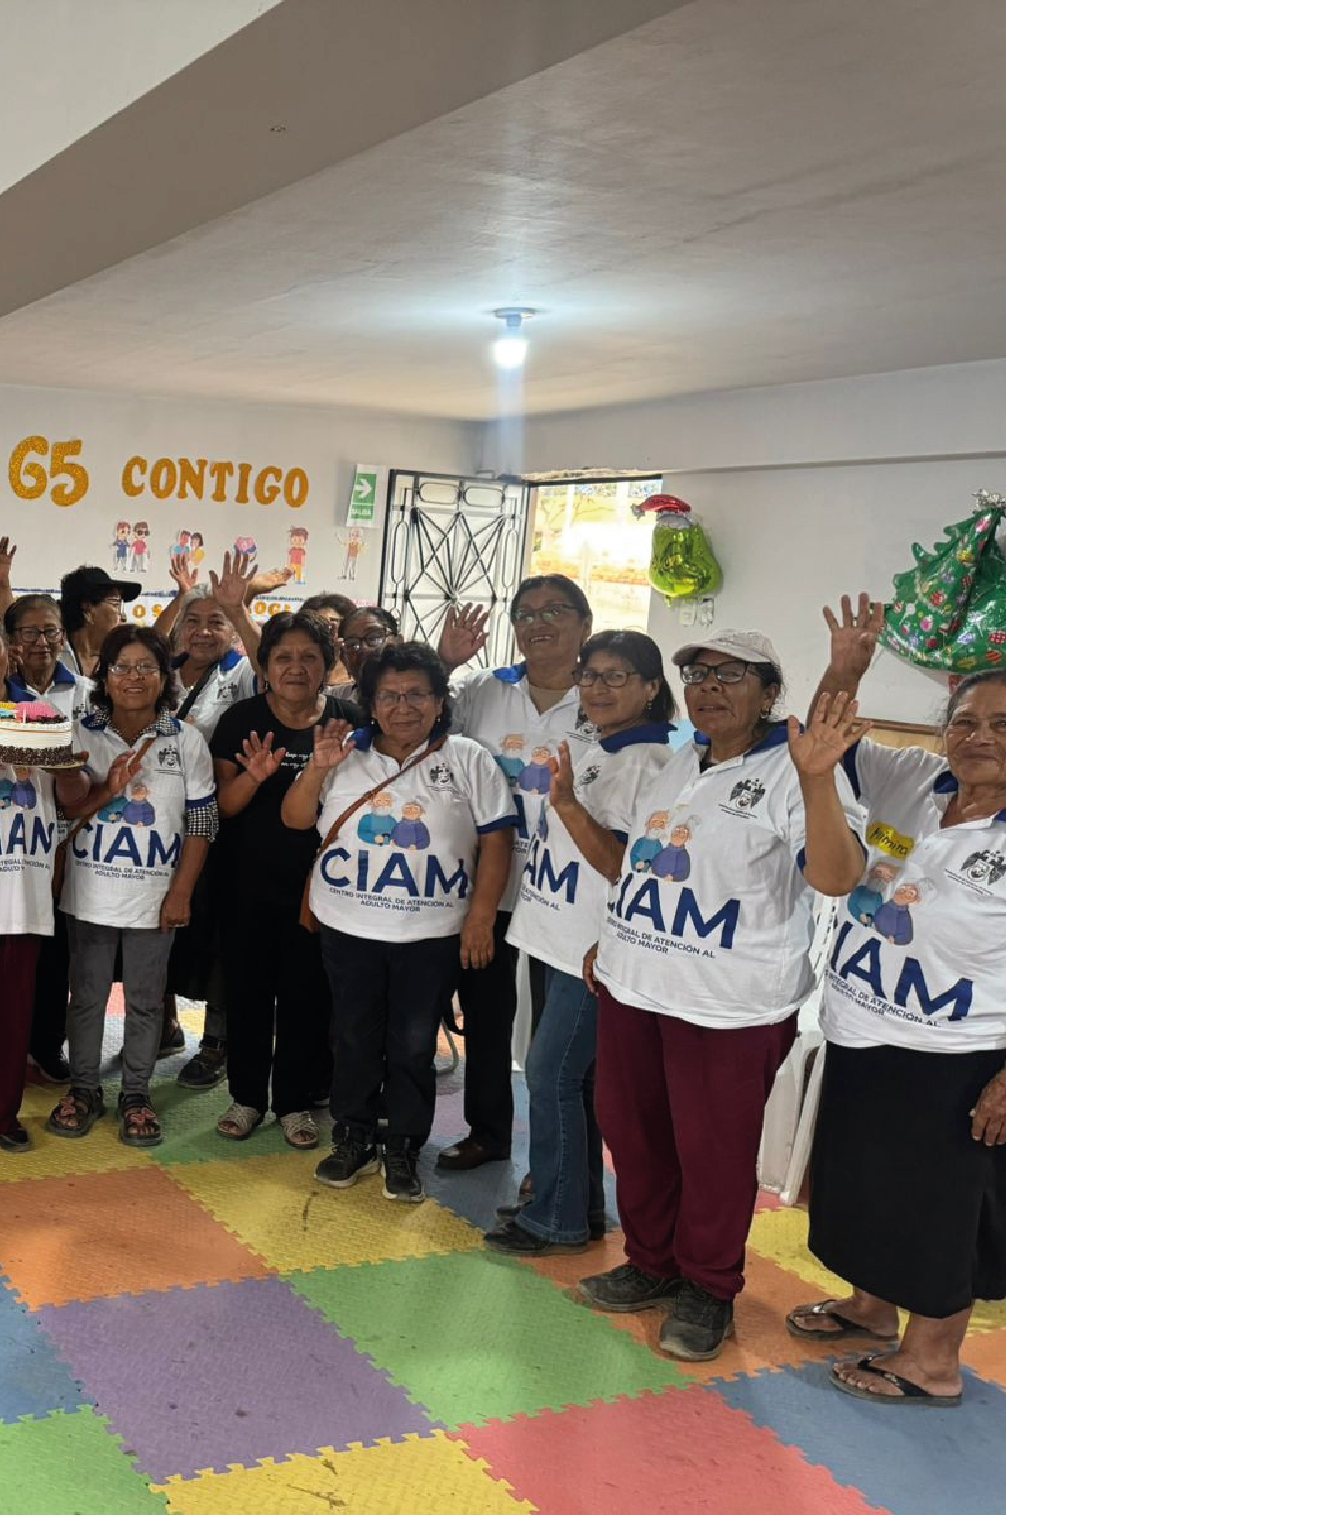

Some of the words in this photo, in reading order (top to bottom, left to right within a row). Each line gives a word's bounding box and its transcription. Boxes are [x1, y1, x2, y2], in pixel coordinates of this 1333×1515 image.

[8, 435, 90, 507] 65
[121, 455, 310, 508] CONTIGO
[72, 822, 181, 868] CIAM
[321, 847, 468, 898] CIAM
[607, 872, 741, 949] IAM
[638, 939, 669, 954] MAYOR
[641, 932, 653, 941] DE
[702, 949, 717, 959] AL
[830, 914, 974, 1022] IAM
